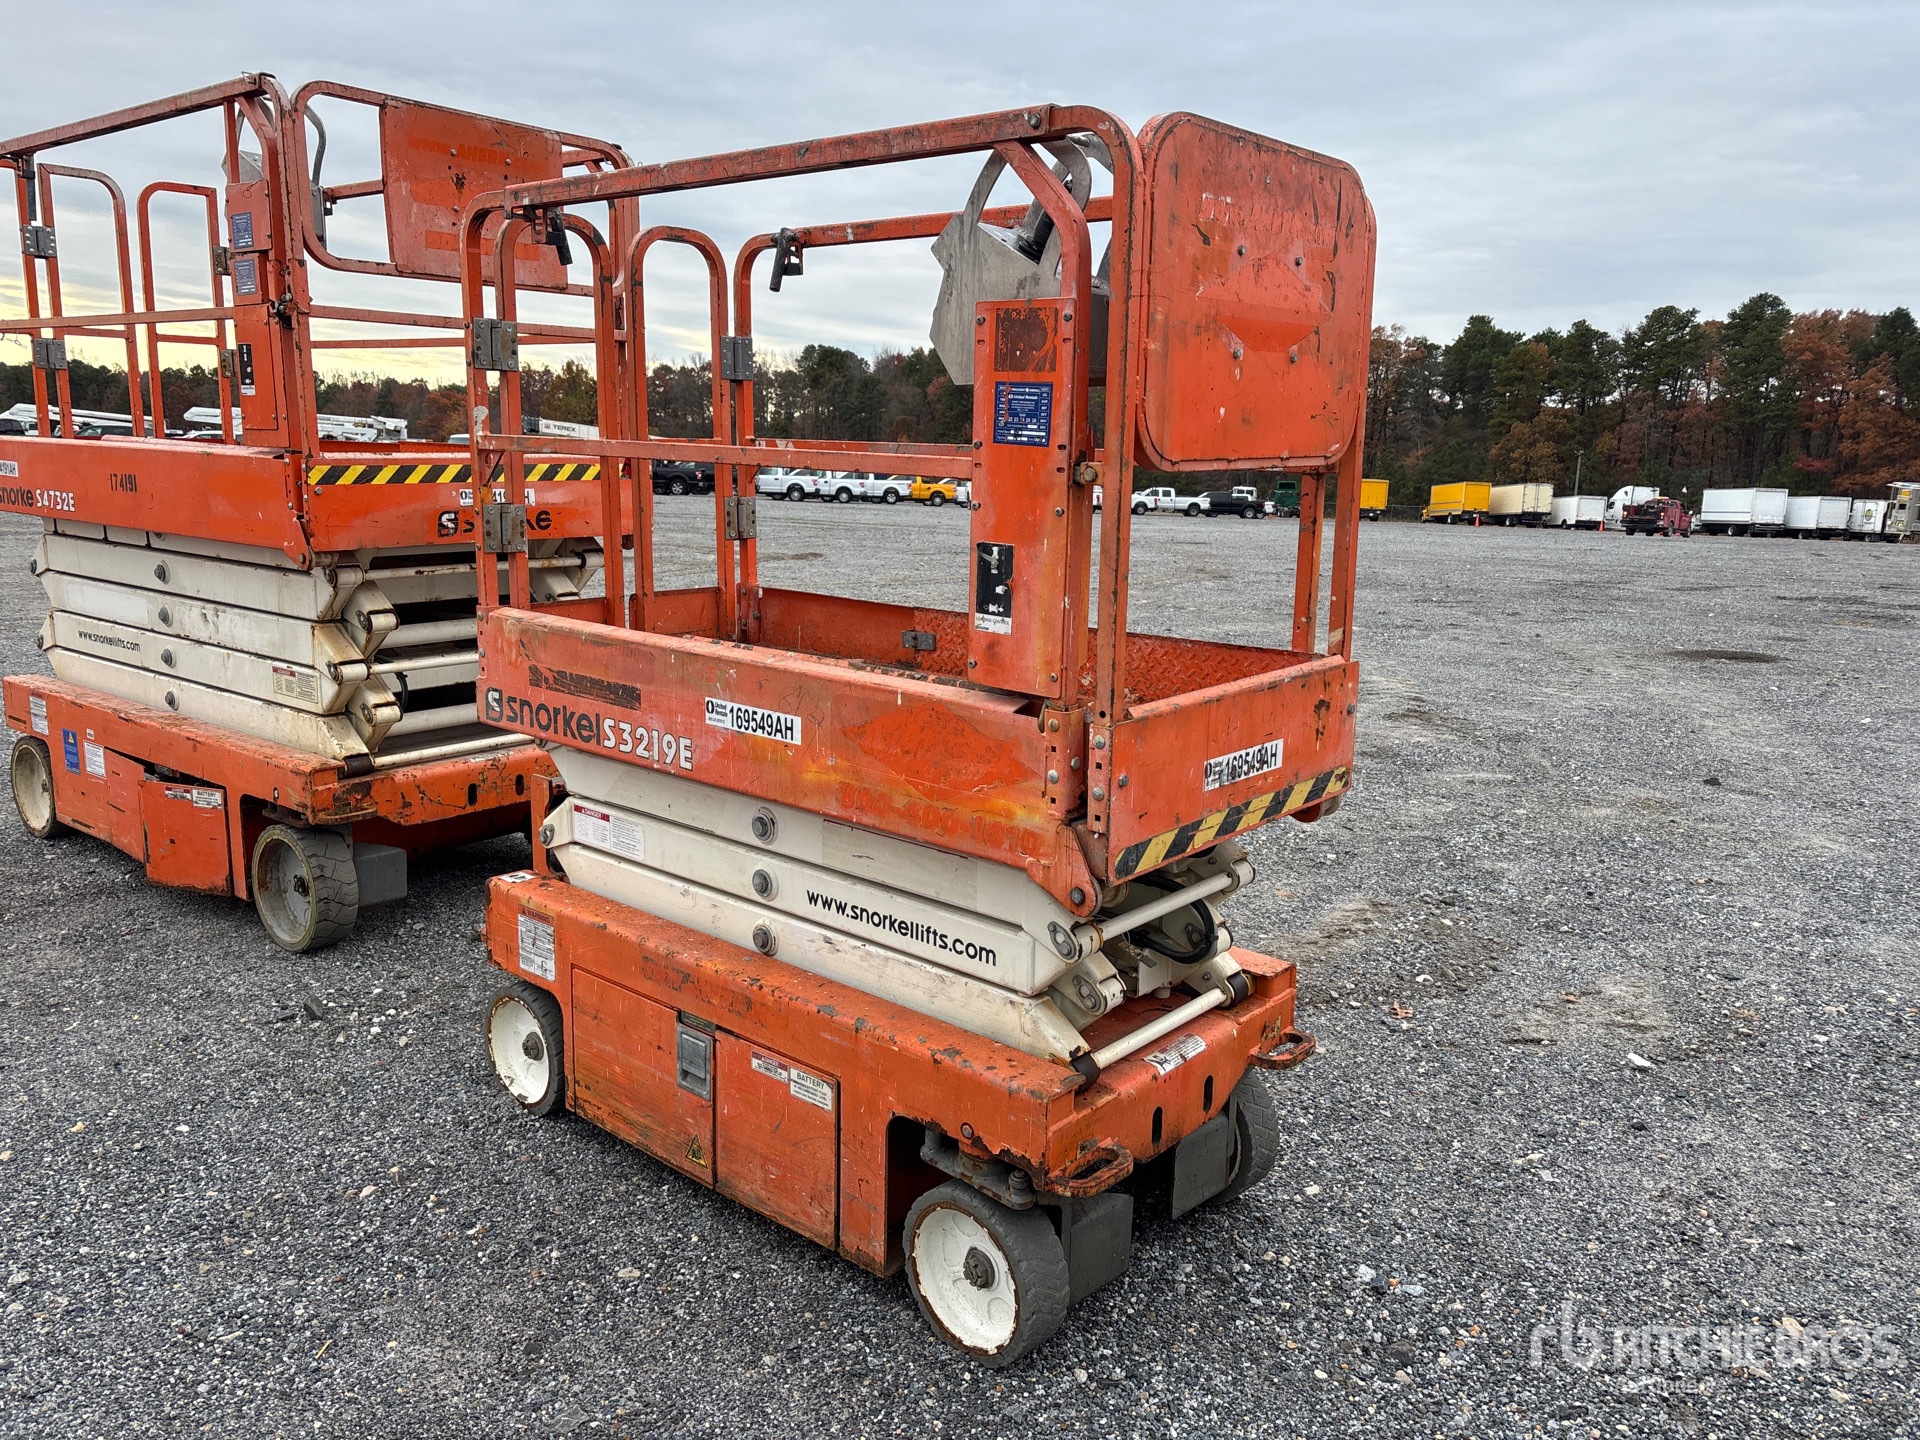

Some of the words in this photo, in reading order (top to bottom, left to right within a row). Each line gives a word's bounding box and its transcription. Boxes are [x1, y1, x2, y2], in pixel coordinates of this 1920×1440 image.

[553, 424, 576, 432] TEREX
[109, 473, 138, 493] 174191
[36, 488, 76, 512] S4732E
[506, 695, 600, 746] snorkel
[602, 717, 693, 771] S3219E
[729, 705, 795, 741] 169549AH
[1226, 743, 1278, 782] 169549AH
[527, 906, 551, 924] WARNING
[806, 890, 997, 967] www.snorkellifts.com
[796, 1072, 825, 1090] BATTERY
